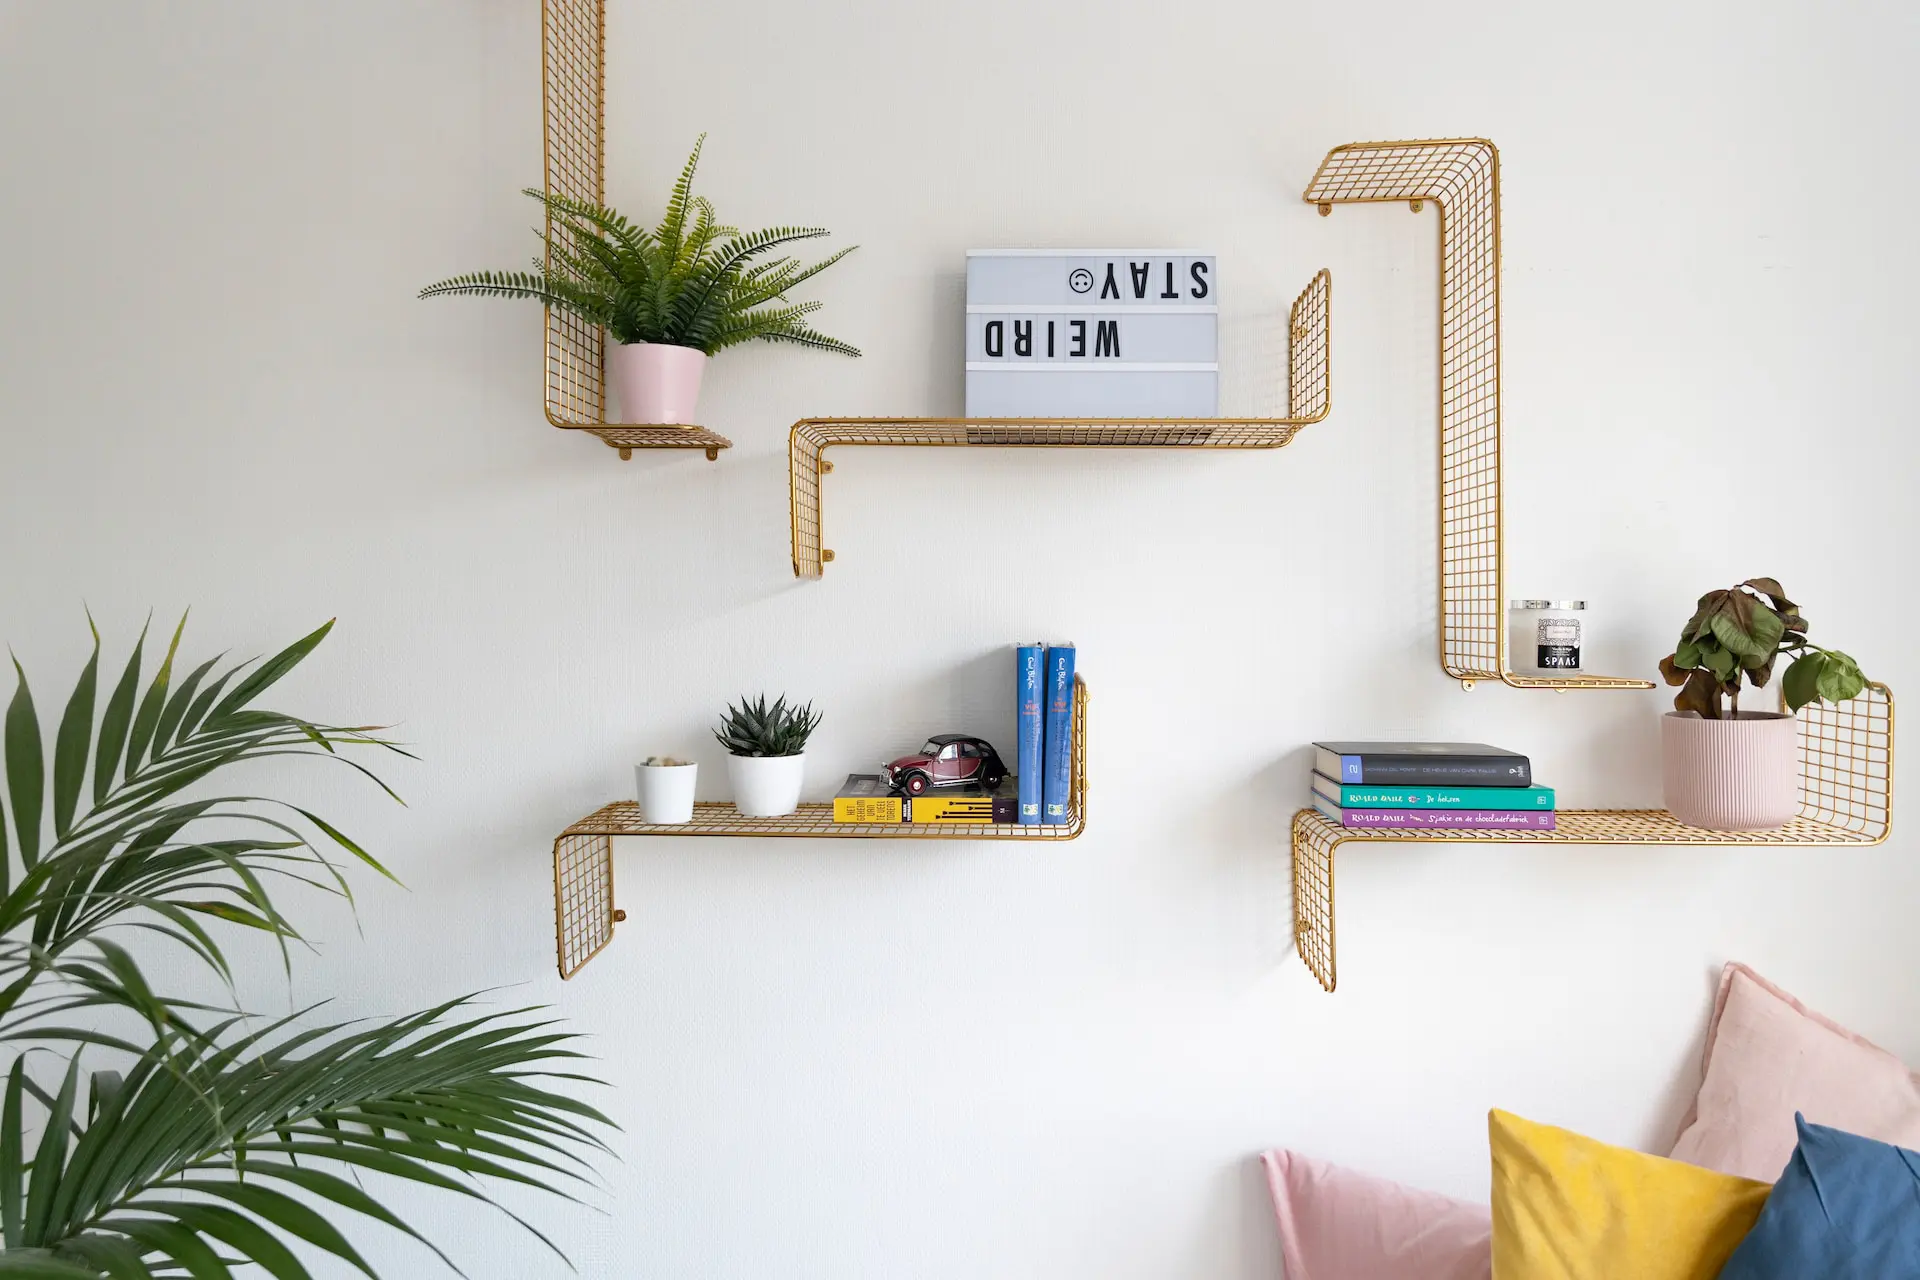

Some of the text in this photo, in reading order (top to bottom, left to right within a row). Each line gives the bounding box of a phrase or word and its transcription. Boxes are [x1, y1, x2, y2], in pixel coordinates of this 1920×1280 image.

[1100, 261, 1208, 299] STAY
[985, 320, 1121, 357] WEIRD
[1545, 657, 1576, 666] SPAAS
[1349, 764, 1358, 774] 2
[1349, 794, 1378, 802] ROALD
[1427, 794, 1435, 803] De
[847, 805, 856, 816] HET
[857, 800, 866, 821] GEHEIM
[1352, 814, 1380, 822] ROALD
